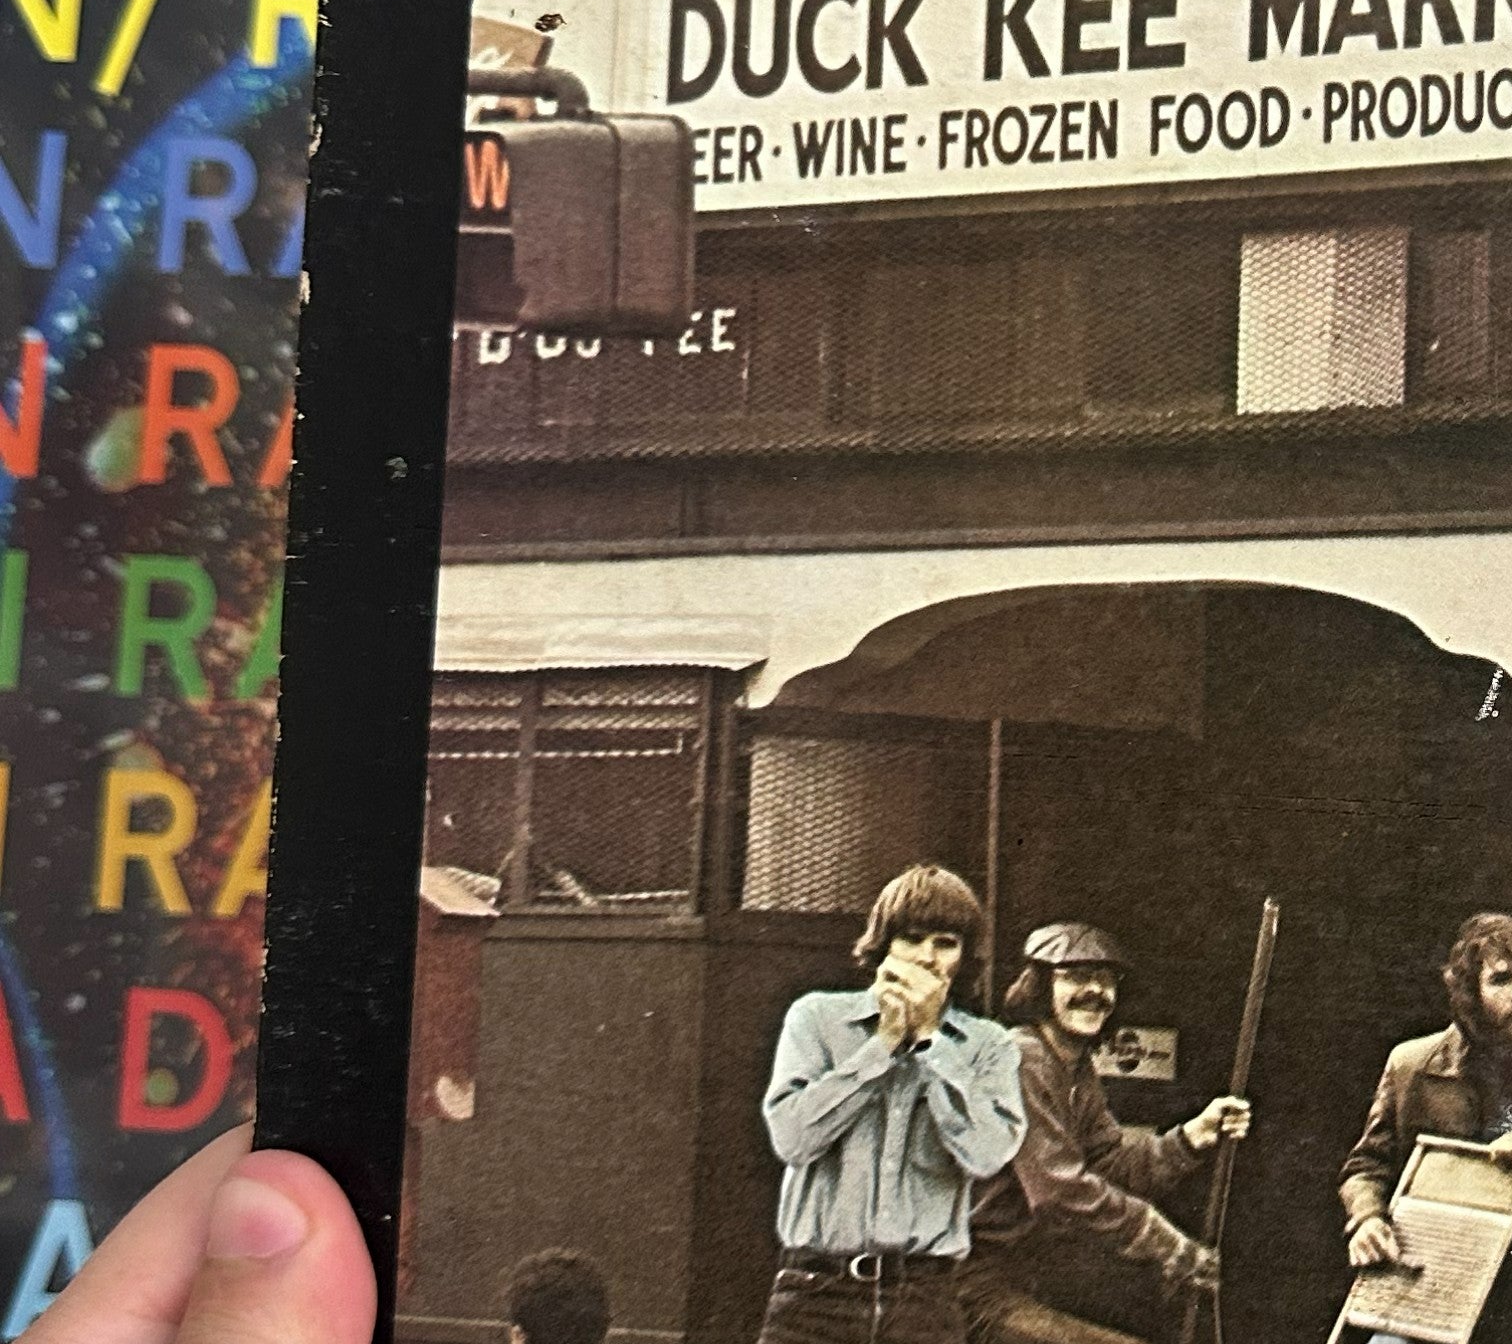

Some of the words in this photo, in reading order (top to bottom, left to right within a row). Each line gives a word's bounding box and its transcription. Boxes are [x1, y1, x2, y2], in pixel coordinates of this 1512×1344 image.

[692, 125, 763, 186] EER
[792, 112, 908, 180] WINE
[938, 98, 1120, 174] FROZEN
[1149, 87, 1291, 156] FOOD
